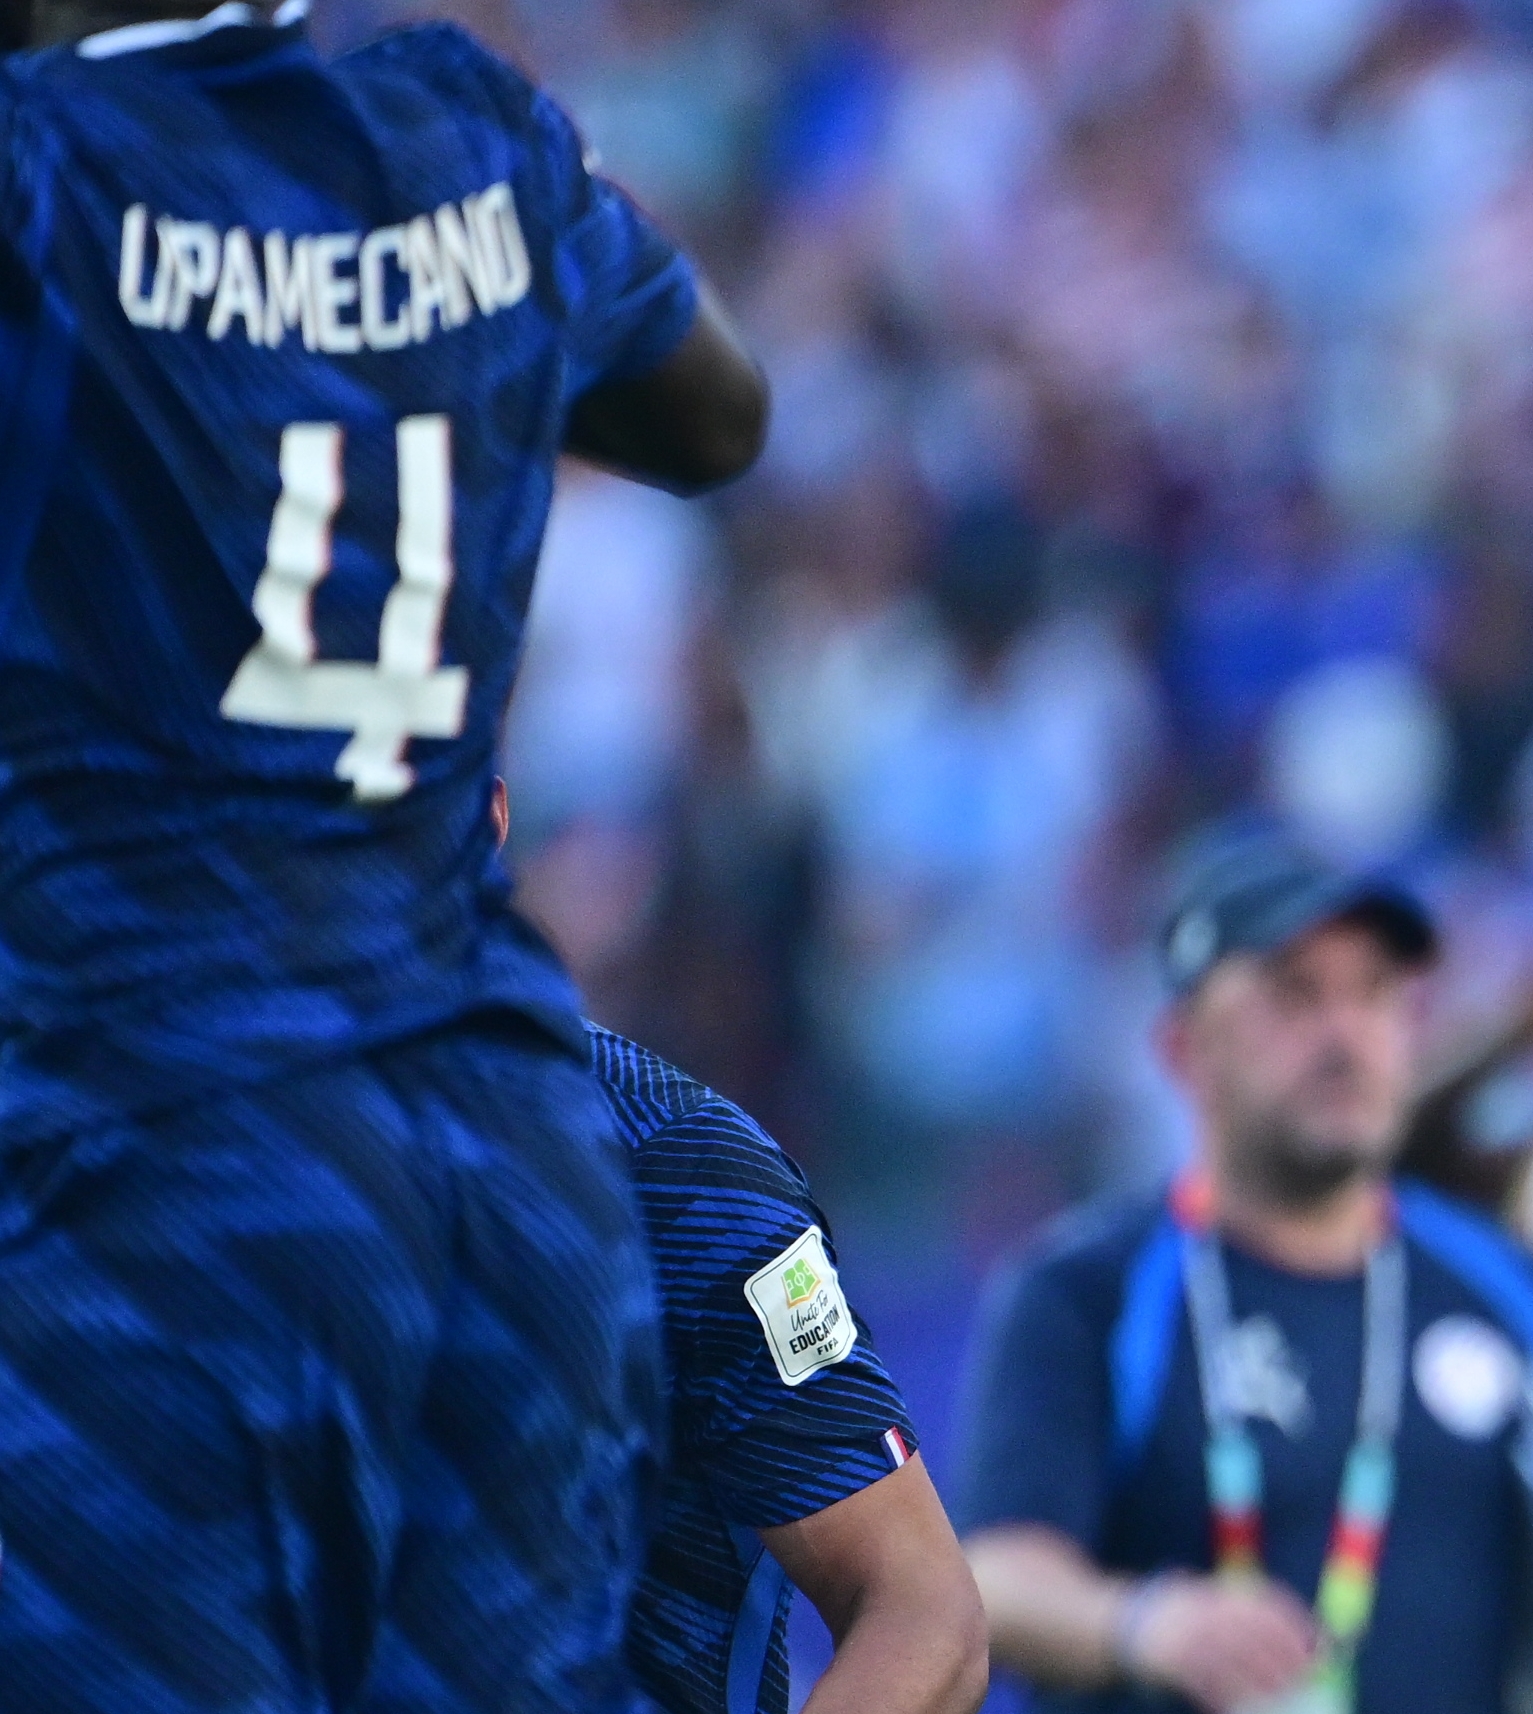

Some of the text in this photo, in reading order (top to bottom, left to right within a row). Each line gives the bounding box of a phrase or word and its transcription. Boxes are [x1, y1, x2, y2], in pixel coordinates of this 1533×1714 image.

[118, 181, 531, 354] UPAMECANO
[220, 412, 469, 801] 4
[789, 1305, 840, 1354] EDUCATION
[816, 1337, 839, 1355] FIFA
